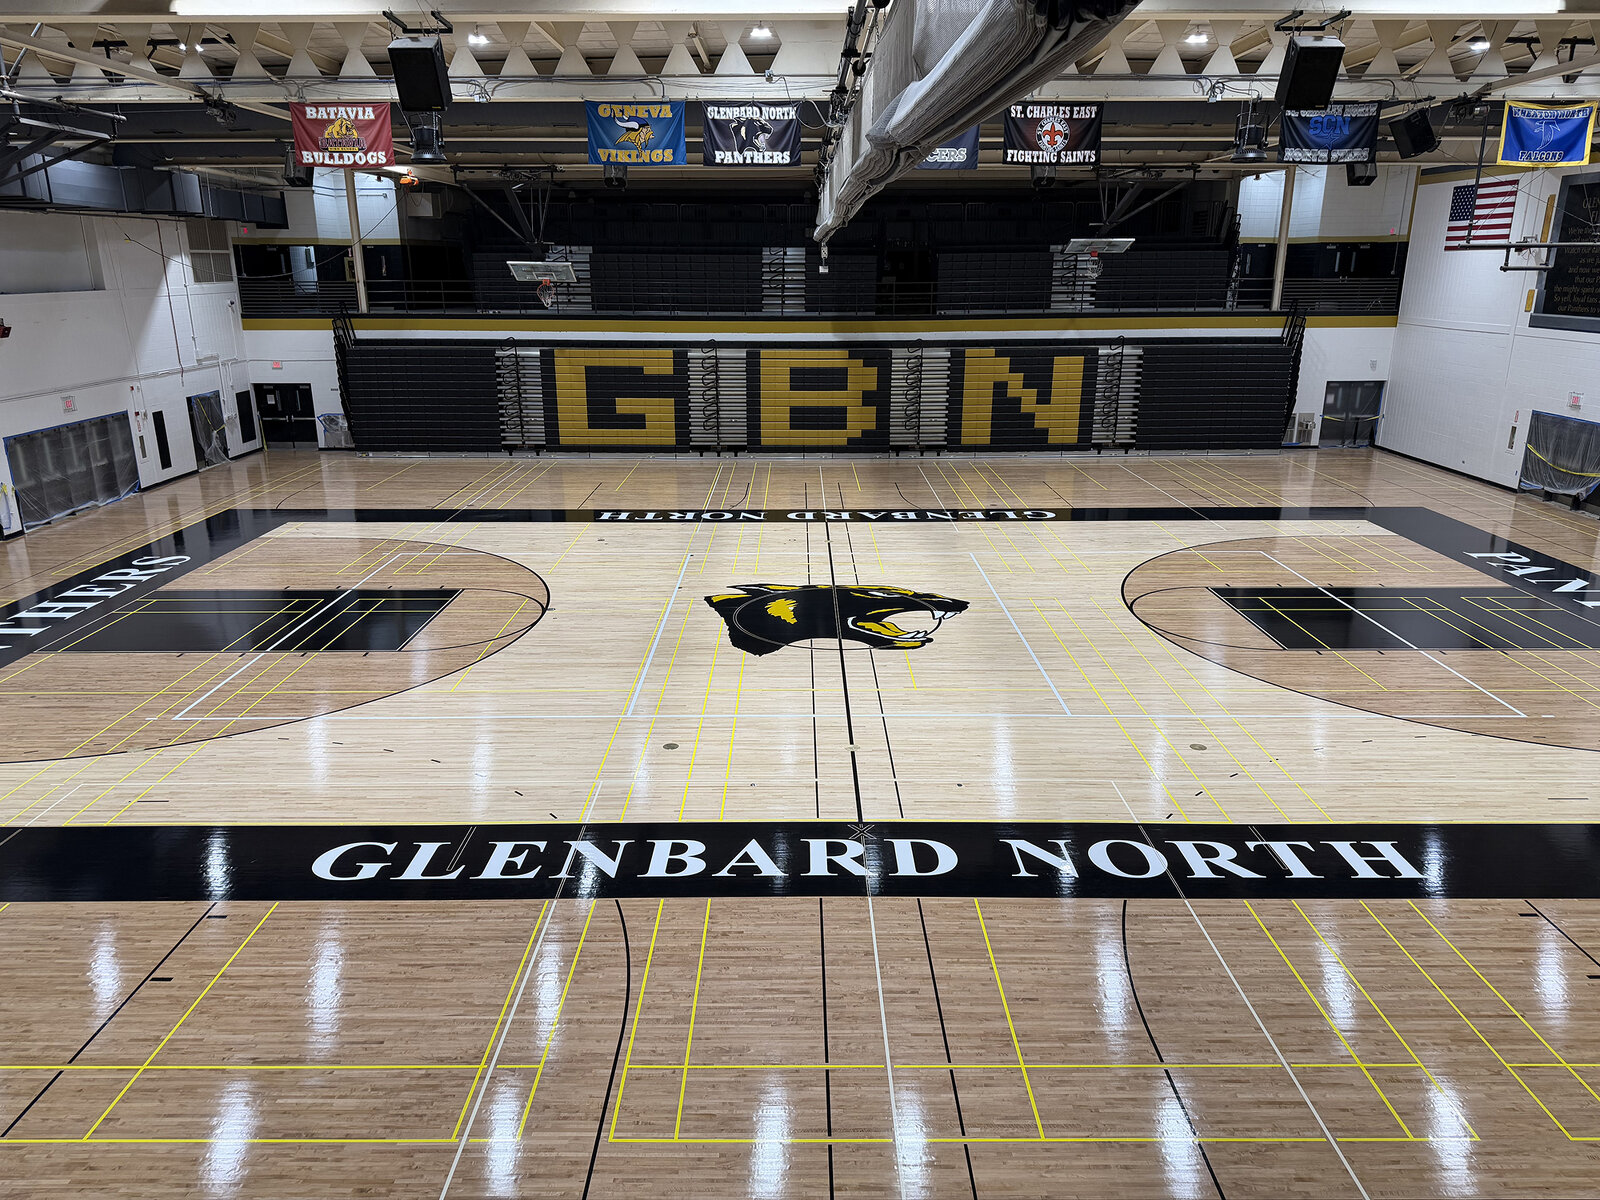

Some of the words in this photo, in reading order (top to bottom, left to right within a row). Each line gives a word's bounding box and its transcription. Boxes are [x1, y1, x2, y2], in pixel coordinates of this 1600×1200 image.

[304, 106, 375, 120] BATAVIA
[597, 104, 672, 118] GENEVA
[707, 105, 761, 120] GLENBARD
[762, 106, 797, 120] NORTH
[1010, 105, 1025, 119] ST.
[1026, 105, 1071, 119] CHARLES
[1073, 105, 1098, 119] EAST
[1512, 107, 1556, 119] WHEATON
[1558, 107, 1590, 119] NORTH
[1308, 114, 1352, 136] SCN
[301, 151, 388, 165] BULLDOGS
[597, 148, 673, 163] VIKINGS
[715, 150, 790, 164] PANTHERS
[922, 147, 968, 162] CERS
[1006, 149, 1058, 163] FIGHTING
[1059, 150, 1096, 163] SAINTS
[1284, 148, 1329, 162] NORTH
[1519, 150, 1564, 161] FALCONS
[598, 511, 768, 521] NORTH
[786, 510, 1057, 521] GLENBARD
[1462, 551, 1600, 609] PAN
[311, 840, 958, 881] GLENBARD
[999, 839, 1425, 879] NORTH
